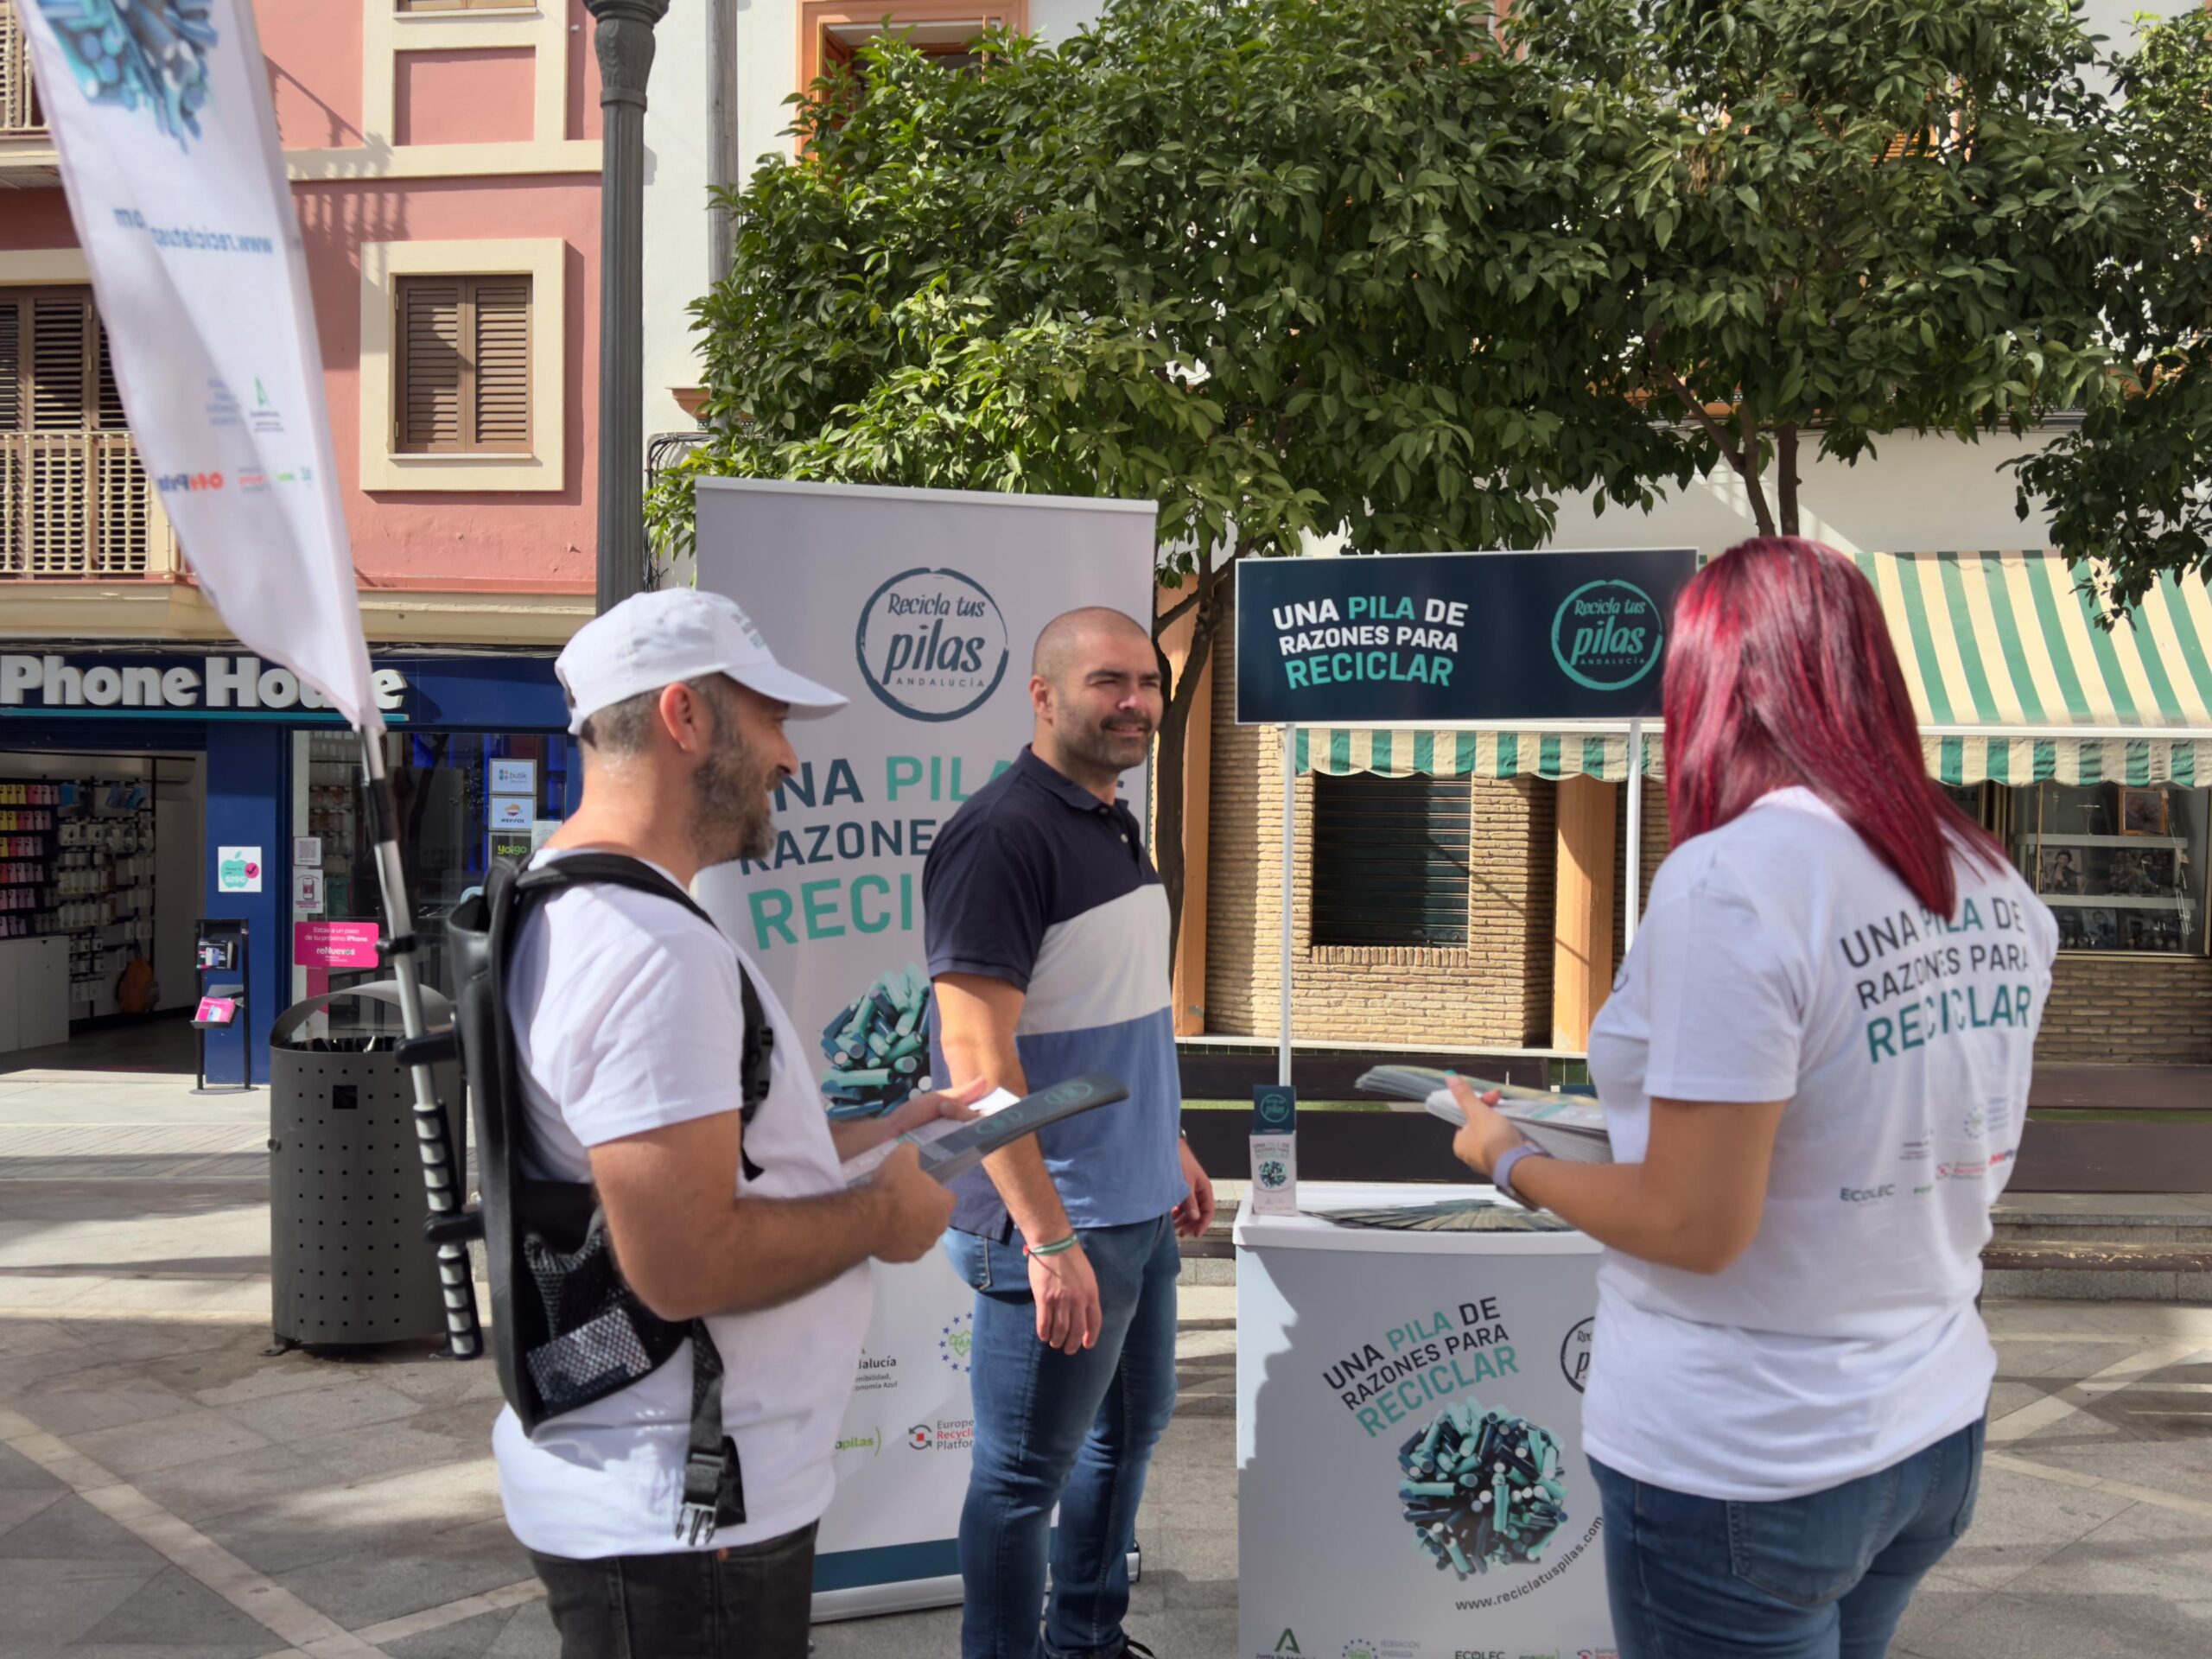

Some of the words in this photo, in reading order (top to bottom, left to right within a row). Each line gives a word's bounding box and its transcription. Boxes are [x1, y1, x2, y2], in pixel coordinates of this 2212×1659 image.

[887, 593, 950, 616] Recicla
[956, 596, 985, 617] tus
[1273, 598, 1339, 630] UNA
[1348, 596, 1415, 620] PILA
[1424, 600, 1469, 627] DE
[1574, 597, 1621, 616] Recicla
[1624, 599, 1645, 614] tus
[881, 618, 985, 685] pilas
[1279, 626, 1389, 656] RAZONES
[1395, 626, 1459, 653] PARA
[1570, 615, 1646, 666] pilas
[0, 655, 200, 706] Phone
[206, 657, 408, 709] Houe
[896, 677, 984, 688] ANDALUCÍA
[1284, 651, 1454, 690] RECICLAR
[510, 771, 527, 779] butik
[775, 759, 864, 811] NA
[498, 845, 526, 855] yoigo
[739, 819, 938, 876] AZONE
[747, 873, 912, 950] RECI
[1840, 910, 1919, 969] UNA
[1992, 897, 2025, 933] DE
[1856, 947, 1961, 1010] RAZONES
[1866, 984, 2031, 1065] RECICLAR
[1322, 1344, 1384, 1390] UNA
[1385, 1312, 1453, 1352] PILA
[1459, 1296, 1501, 1325] DE
[1341, 1344, 1440, 1410] RAZONES
[1445, 1324, 1509, 1355] PARA
[1356, 1345, 1520, 1439] RECICLAR
[937, 1420, 975, 1431] Europe
[937, 1428, 975, 1440] Recycli
[937, 1440, 974, 1450] Platfor
[1456, 1516, 1604, 1611] www.reciclatuspilas.com
[1455, 1650, 1505, 1659] ECOLEC
